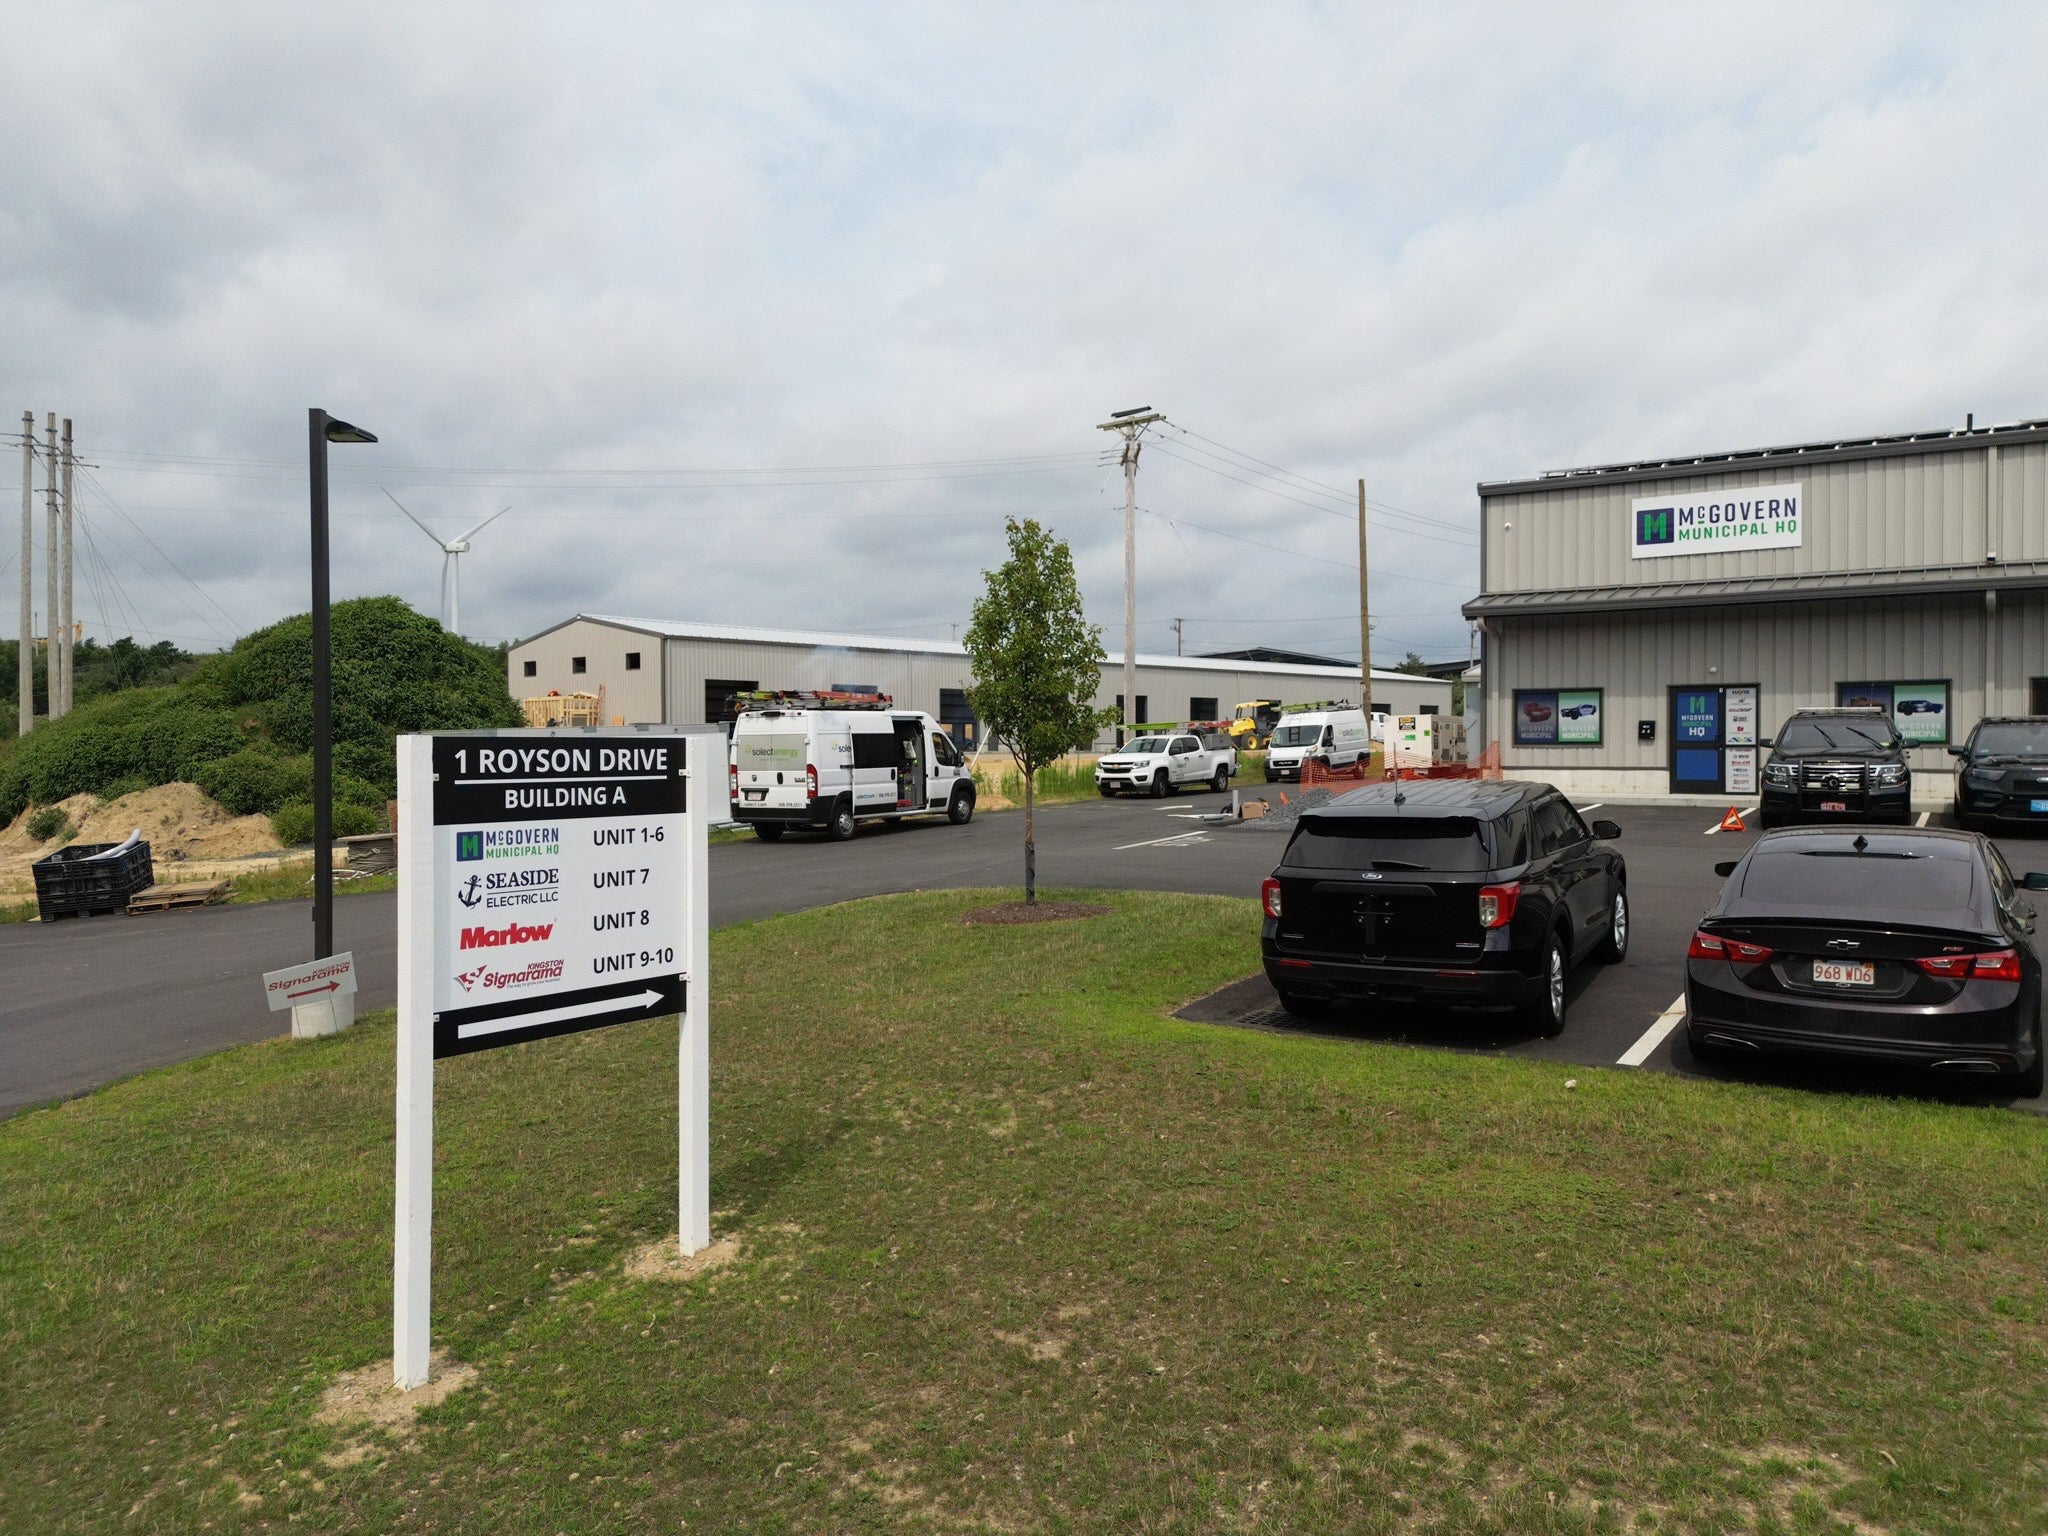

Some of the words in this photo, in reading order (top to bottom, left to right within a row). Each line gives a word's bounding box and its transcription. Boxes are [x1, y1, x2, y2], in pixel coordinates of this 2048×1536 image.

[1679, 498, 1797, 526] McGOVERN
[1679, 523, 1769, 541] MUNICIPAL
[1776, 519, 1797, 535] HQ
[1689, 727, 1705, 737] HQ
[838, 745, 851, 753] sole
[454, 749, 468, 773] 1
[479, 748, 591, 773] ROYSON
[600, 748, 668, 771] DRIVE
[504, 786, 607, 809] BUILDING
[612, 786, 627, 805] A
[486, 828, 559, 846] McGOVERN
[593, 828, 636, 846] UNIT
[640, 826, 665, 843] 1-6
[486, 845, 543, 859] MUNICIPAL
[546, 844, 560, 855] HQ
[486, 868, 559, 889] SEASIDE
[593, 870, 636, 888] UNIT
[640, 868, 650, 885] 7
[486, 893, 538, 908] ELECTRIC
[540, 892, 559, 903] LLC
[593, 912, 636, 931] UNIT
[640, 910, 650, 926] 8
[460, 923, 554, 950] Marlow
[312, 961, 351, 975] KINGSTON
[527, 959, 565, 970] KINGSTON
[593, 953, 636, 974] UNIT
[639, 947, 674, 968] 9-10
[268, 965, 350, 991] Signarama
[483, 966, 563, 989] Signarama
[1815, 965, 1841, 980] 968
[1845, 967, 1872, 983] WD6
